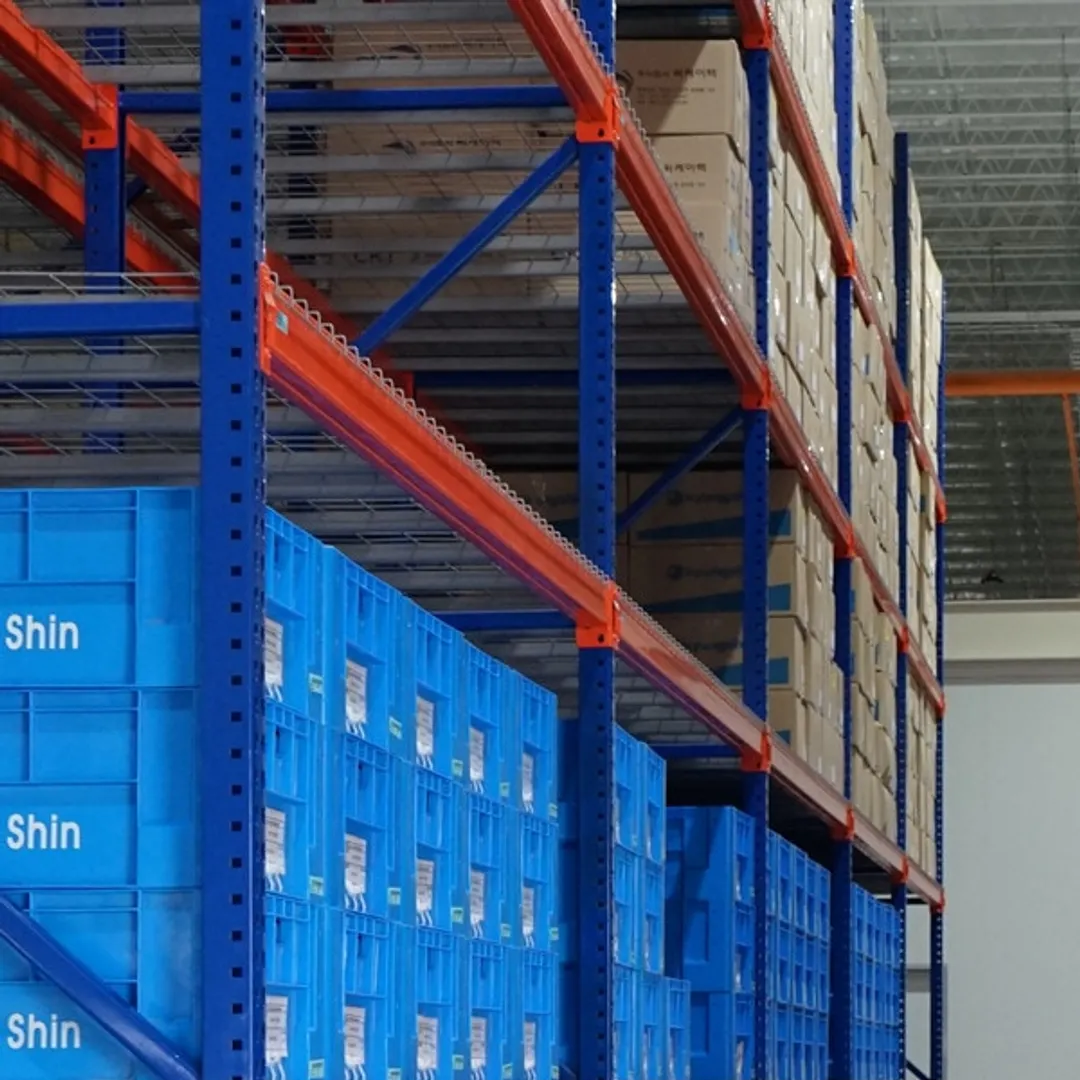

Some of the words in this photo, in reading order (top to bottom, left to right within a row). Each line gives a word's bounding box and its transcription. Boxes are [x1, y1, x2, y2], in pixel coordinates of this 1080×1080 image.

[5, 613, 79, 651] Shin
[6, 813, 81, 850] Shin
[7, 1012, 81, 1050] Shin
